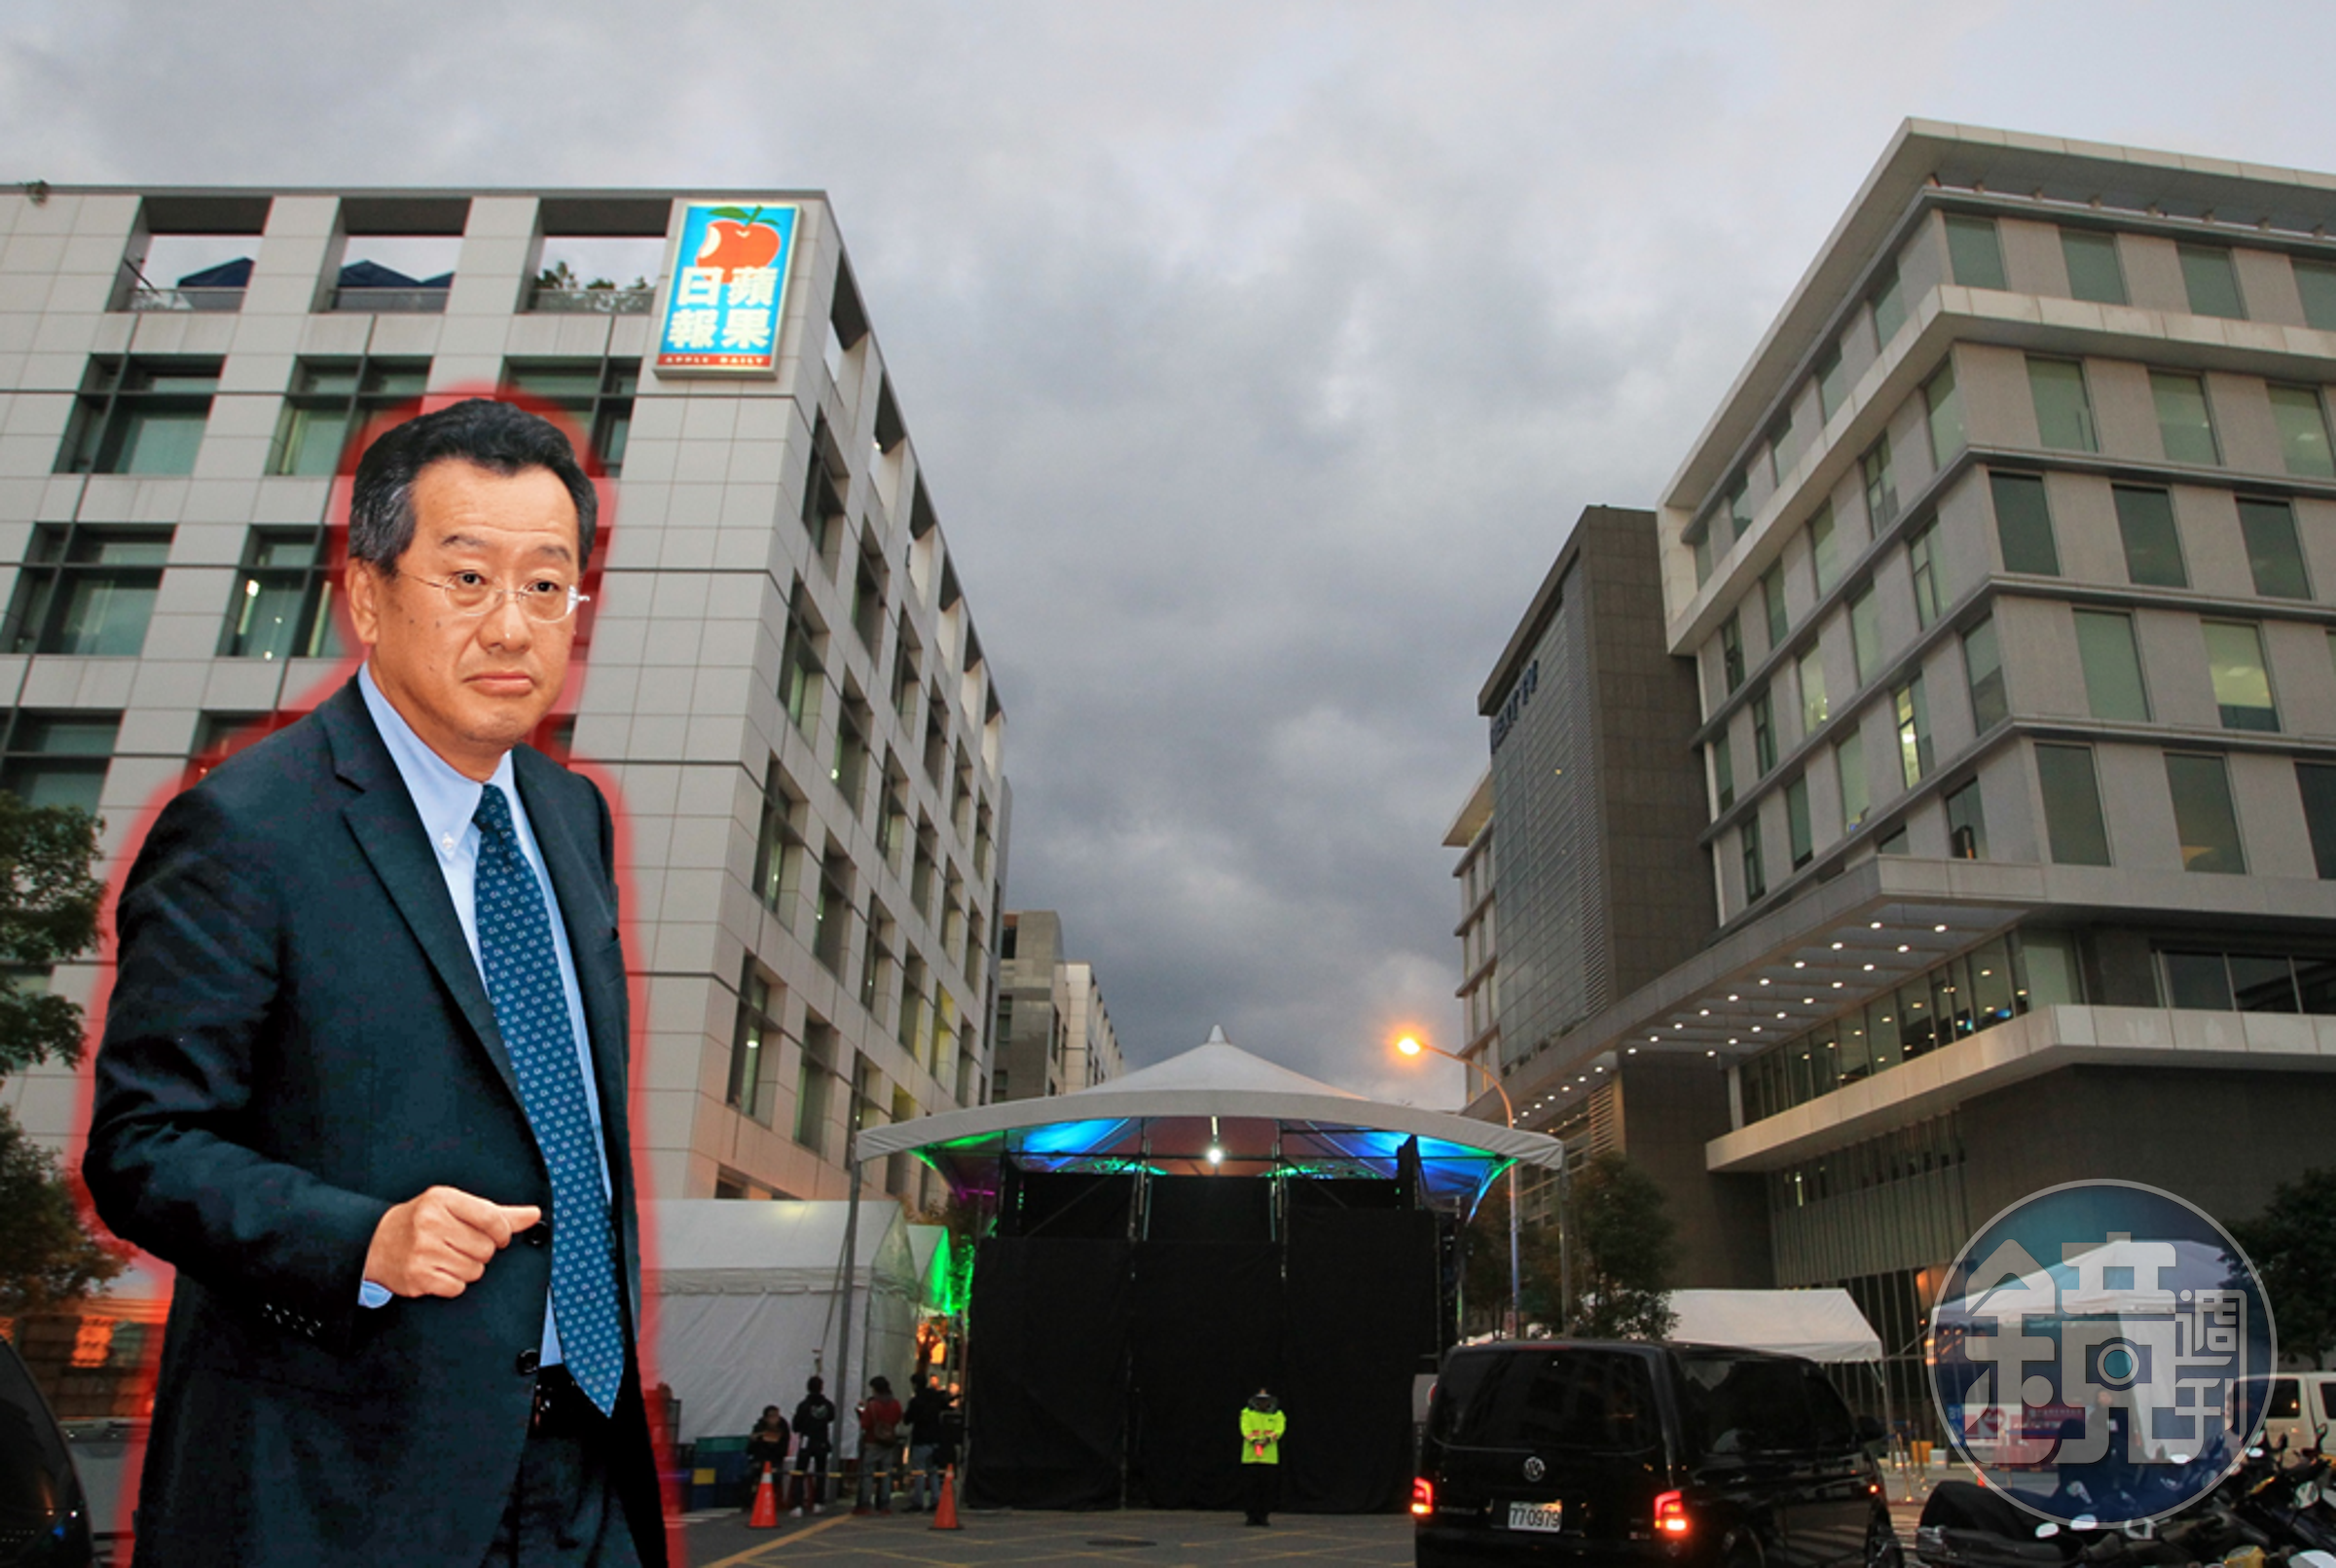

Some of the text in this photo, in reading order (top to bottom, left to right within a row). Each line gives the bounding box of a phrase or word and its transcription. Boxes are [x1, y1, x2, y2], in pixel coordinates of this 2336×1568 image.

[668, 266, 725, 349] 日報
[720, 266, 779, 349] 蘋果
[665, 355, 764, 365] APPLE DAILY
